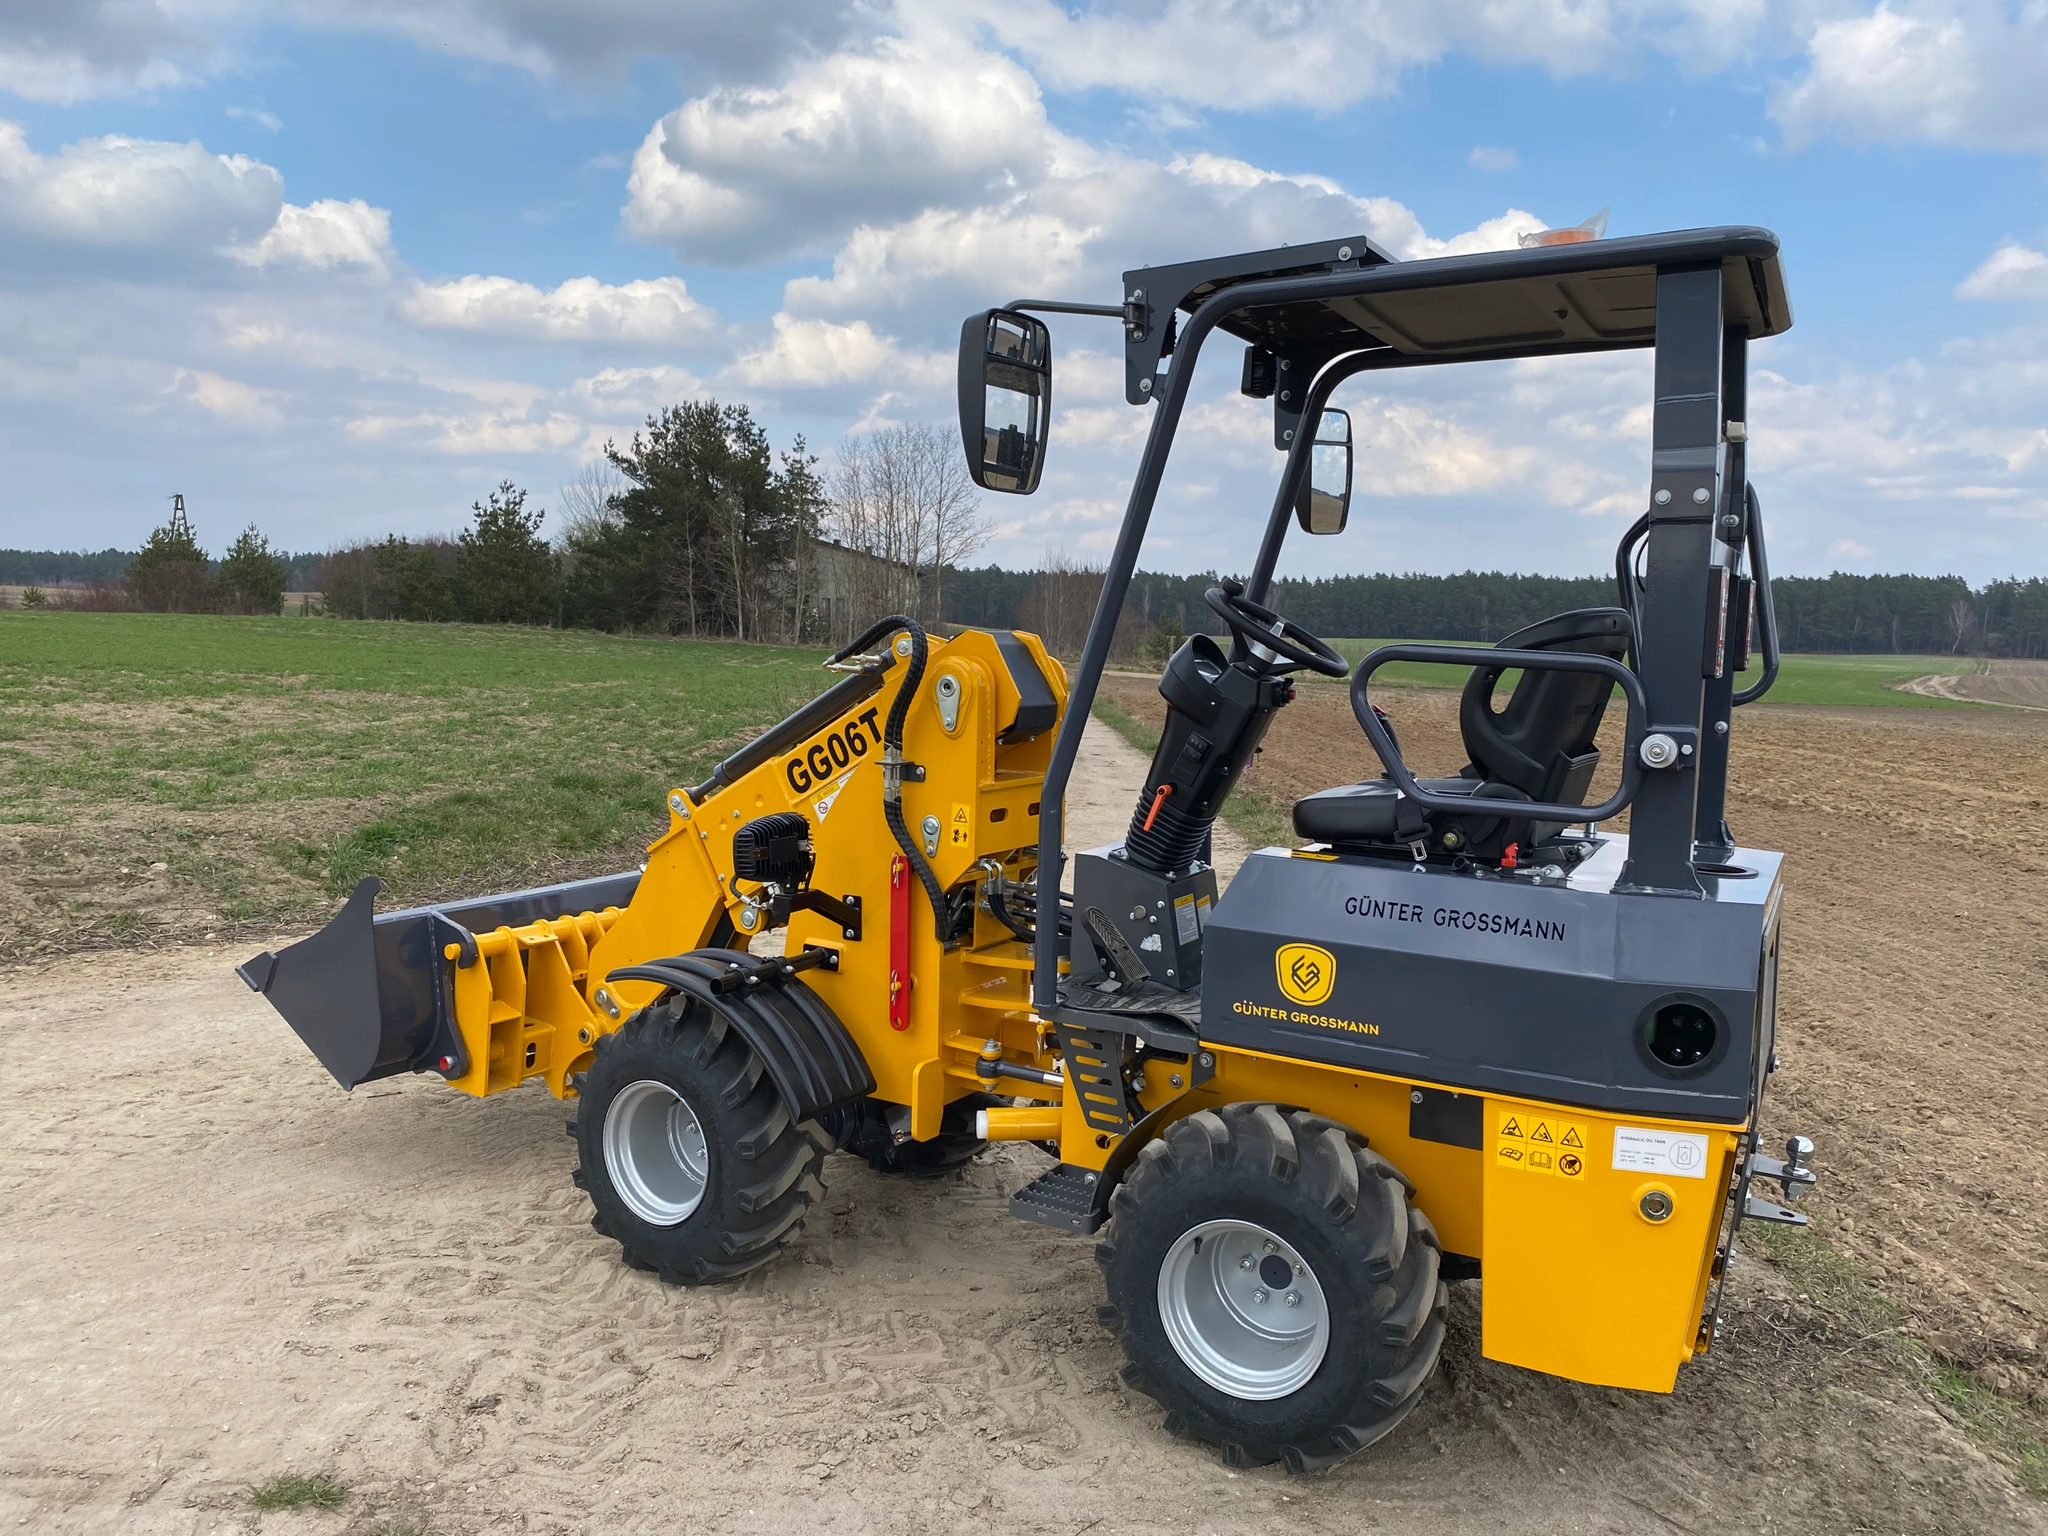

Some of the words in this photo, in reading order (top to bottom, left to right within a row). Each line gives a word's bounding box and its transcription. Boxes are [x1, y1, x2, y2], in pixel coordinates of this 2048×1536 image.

[786, 706, 882, 793] GG06T
[1345, 895, 1423, 923] GÜNTER
[1433, 908, 1565, 941] GROSSMANN
[1232, 999, 1288, 1021] GÜNTER
[1290, 1012, 1379, 1035] GROSSMANN
